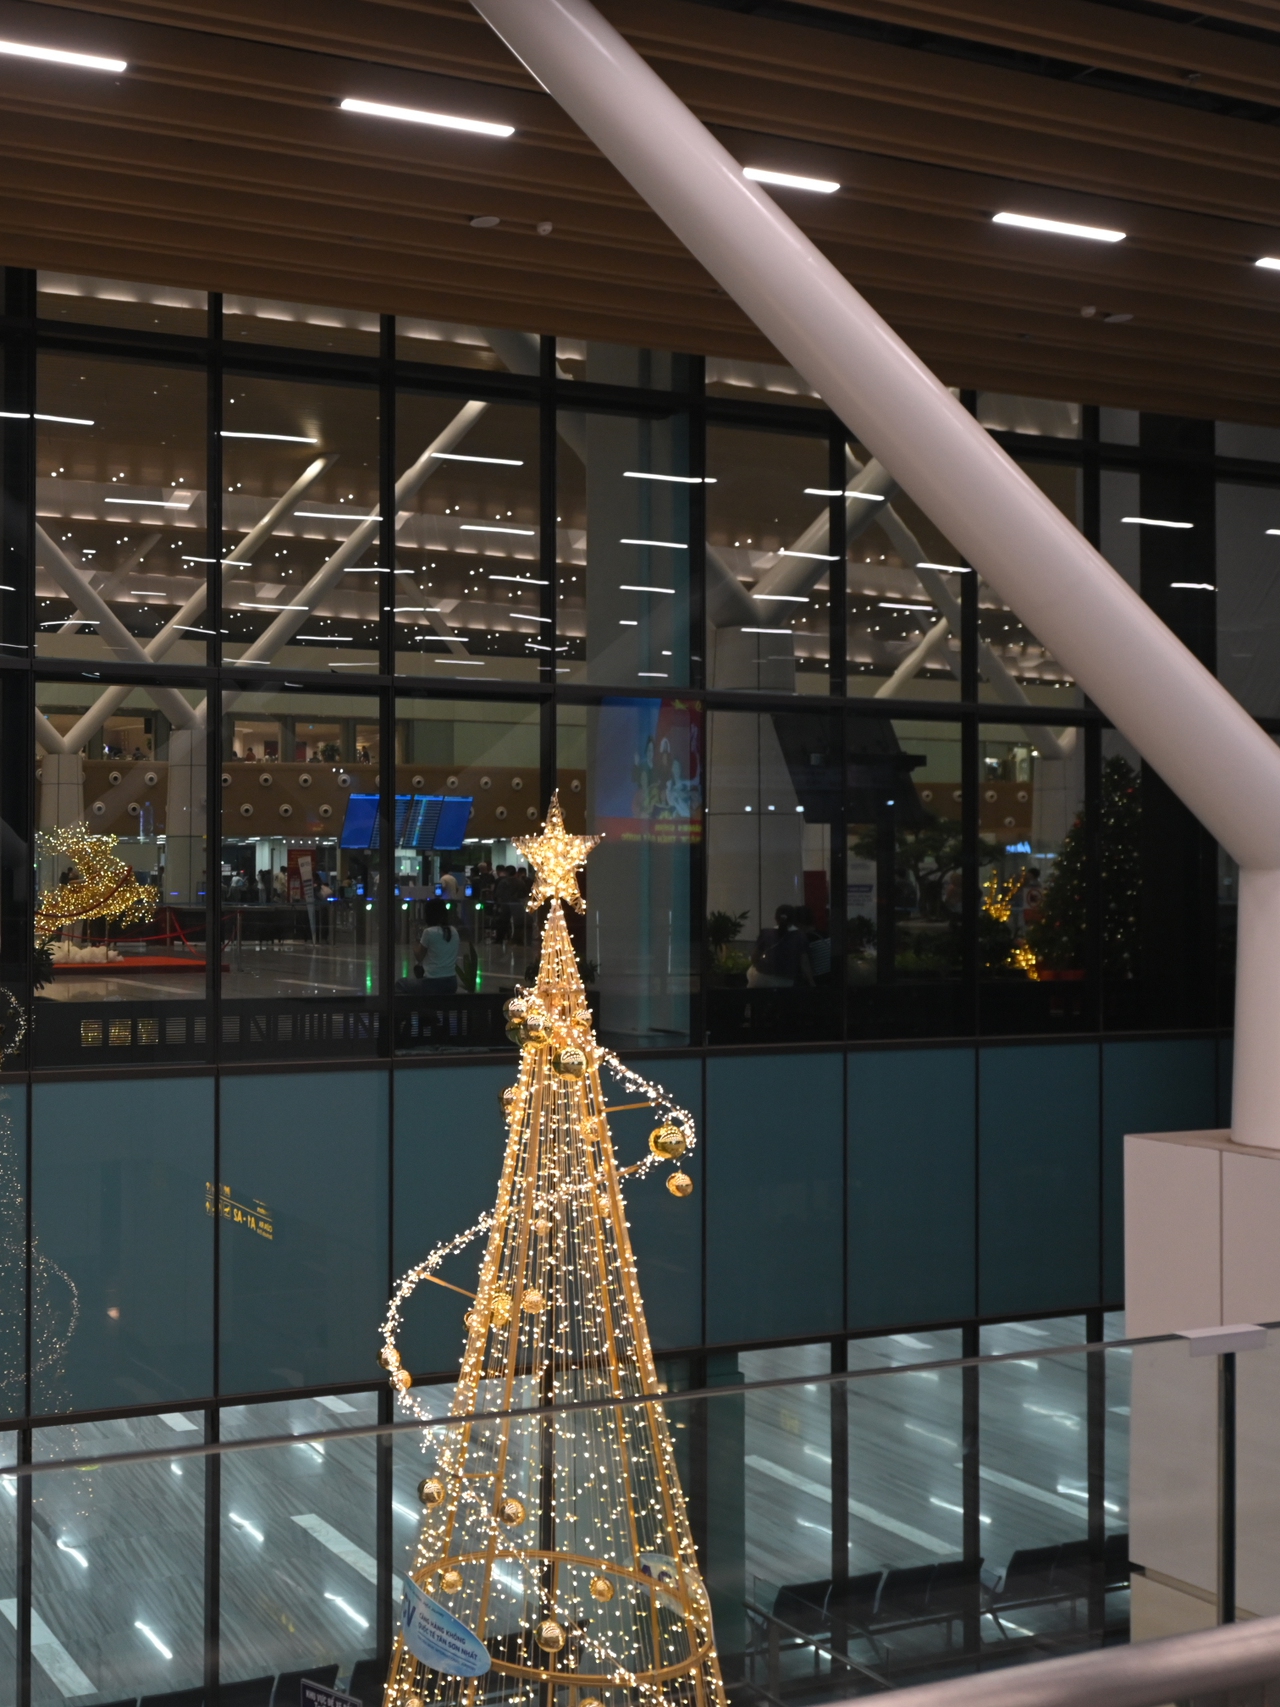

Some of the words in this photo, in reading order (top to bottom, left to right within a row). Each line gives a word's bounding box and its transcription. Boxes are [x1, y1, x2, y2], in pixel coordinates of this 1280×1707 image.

[430, 1621, 445, 1634] HÀNG
[446, 1629, 466, 1645] KHÔNG
[436, 1634, 447, 1646] TÂN
[448, 1641, 461, 1653] SƠN
[461, 1648, 478, 1661] NHẤT
